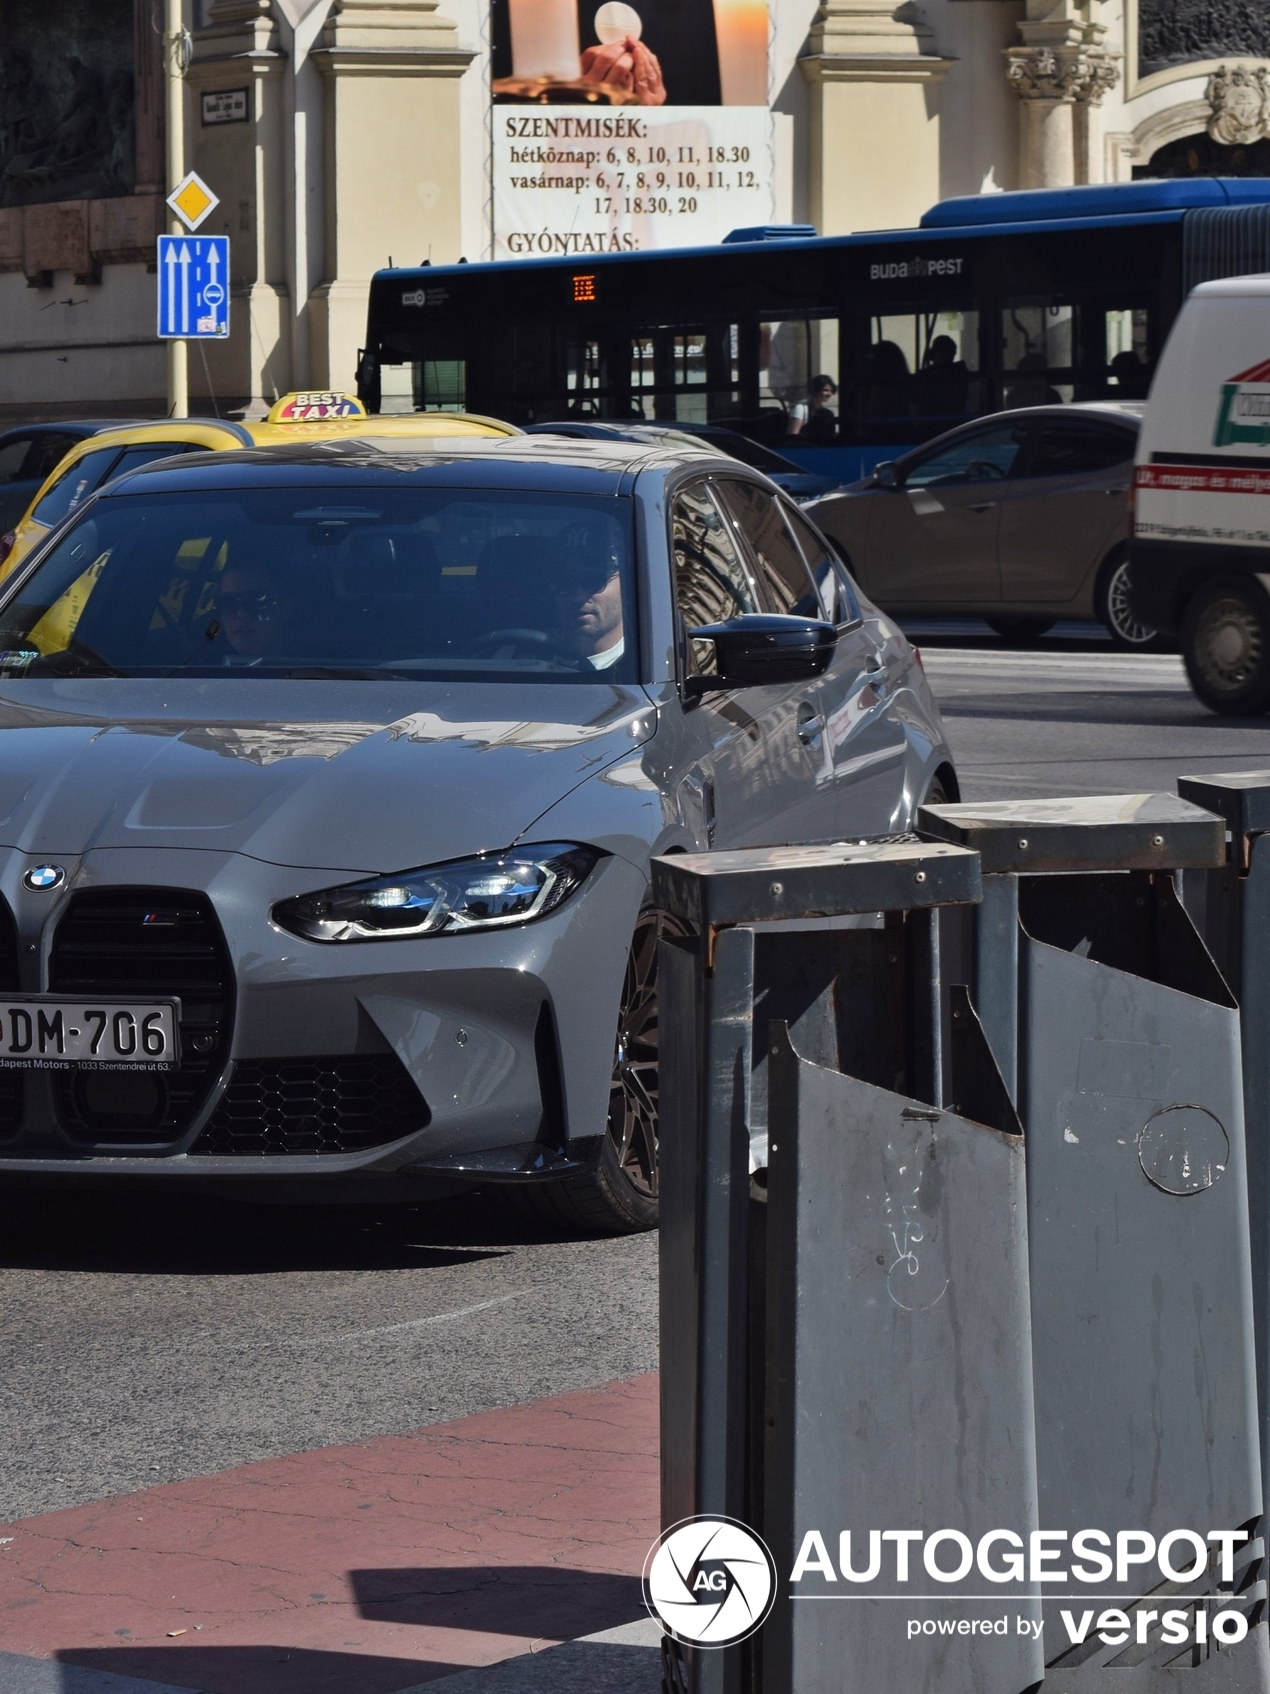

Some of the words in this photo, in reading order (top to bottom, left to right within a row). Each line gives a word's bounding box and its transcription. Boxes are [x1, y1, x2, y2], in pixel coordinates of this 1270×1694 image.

[506, 112, 647, 138] SZENTMISÉK:
[510, 146, 600, 169] hétköznap:
[606, 147, 621, 167] 6,
[627, 147, 641, 166] 8,
[648, 147, 671, 166] 10,
[678, 147, 701, 166] 11,
[708, 147, 750, 163] 18.30
[510, 172, 590, 194] vasárnap:
[596, 172, 610, 192] 6,
[617, 172, 630, 191] 7,
[636, 172, 651, 191] 8,
[656, 172, 671, 191] 9,
[678, 172, 700, 191] 10,
[708, 172, 730, 191] 11,
[737, 171, 760, 191] 12,
[595, 198, 618, 217] 17,
[624, 197, 672, 217] 18.30,
[678, 197, 698, 214] 20
[507, 227, 640, 254] GYÓNTATÁS:
[296, 393, 345, 406] BEST
[291, 405, 350, 420] TAXI
[8, 1008, 166, 1056] DM-706
[34, 1060, 70, 1070] Motors
[78, 1062, 98, 1070] 1033
[99, 1062, 146, 1071] Szentendrei
[148, 1063, 157, 1071] út
